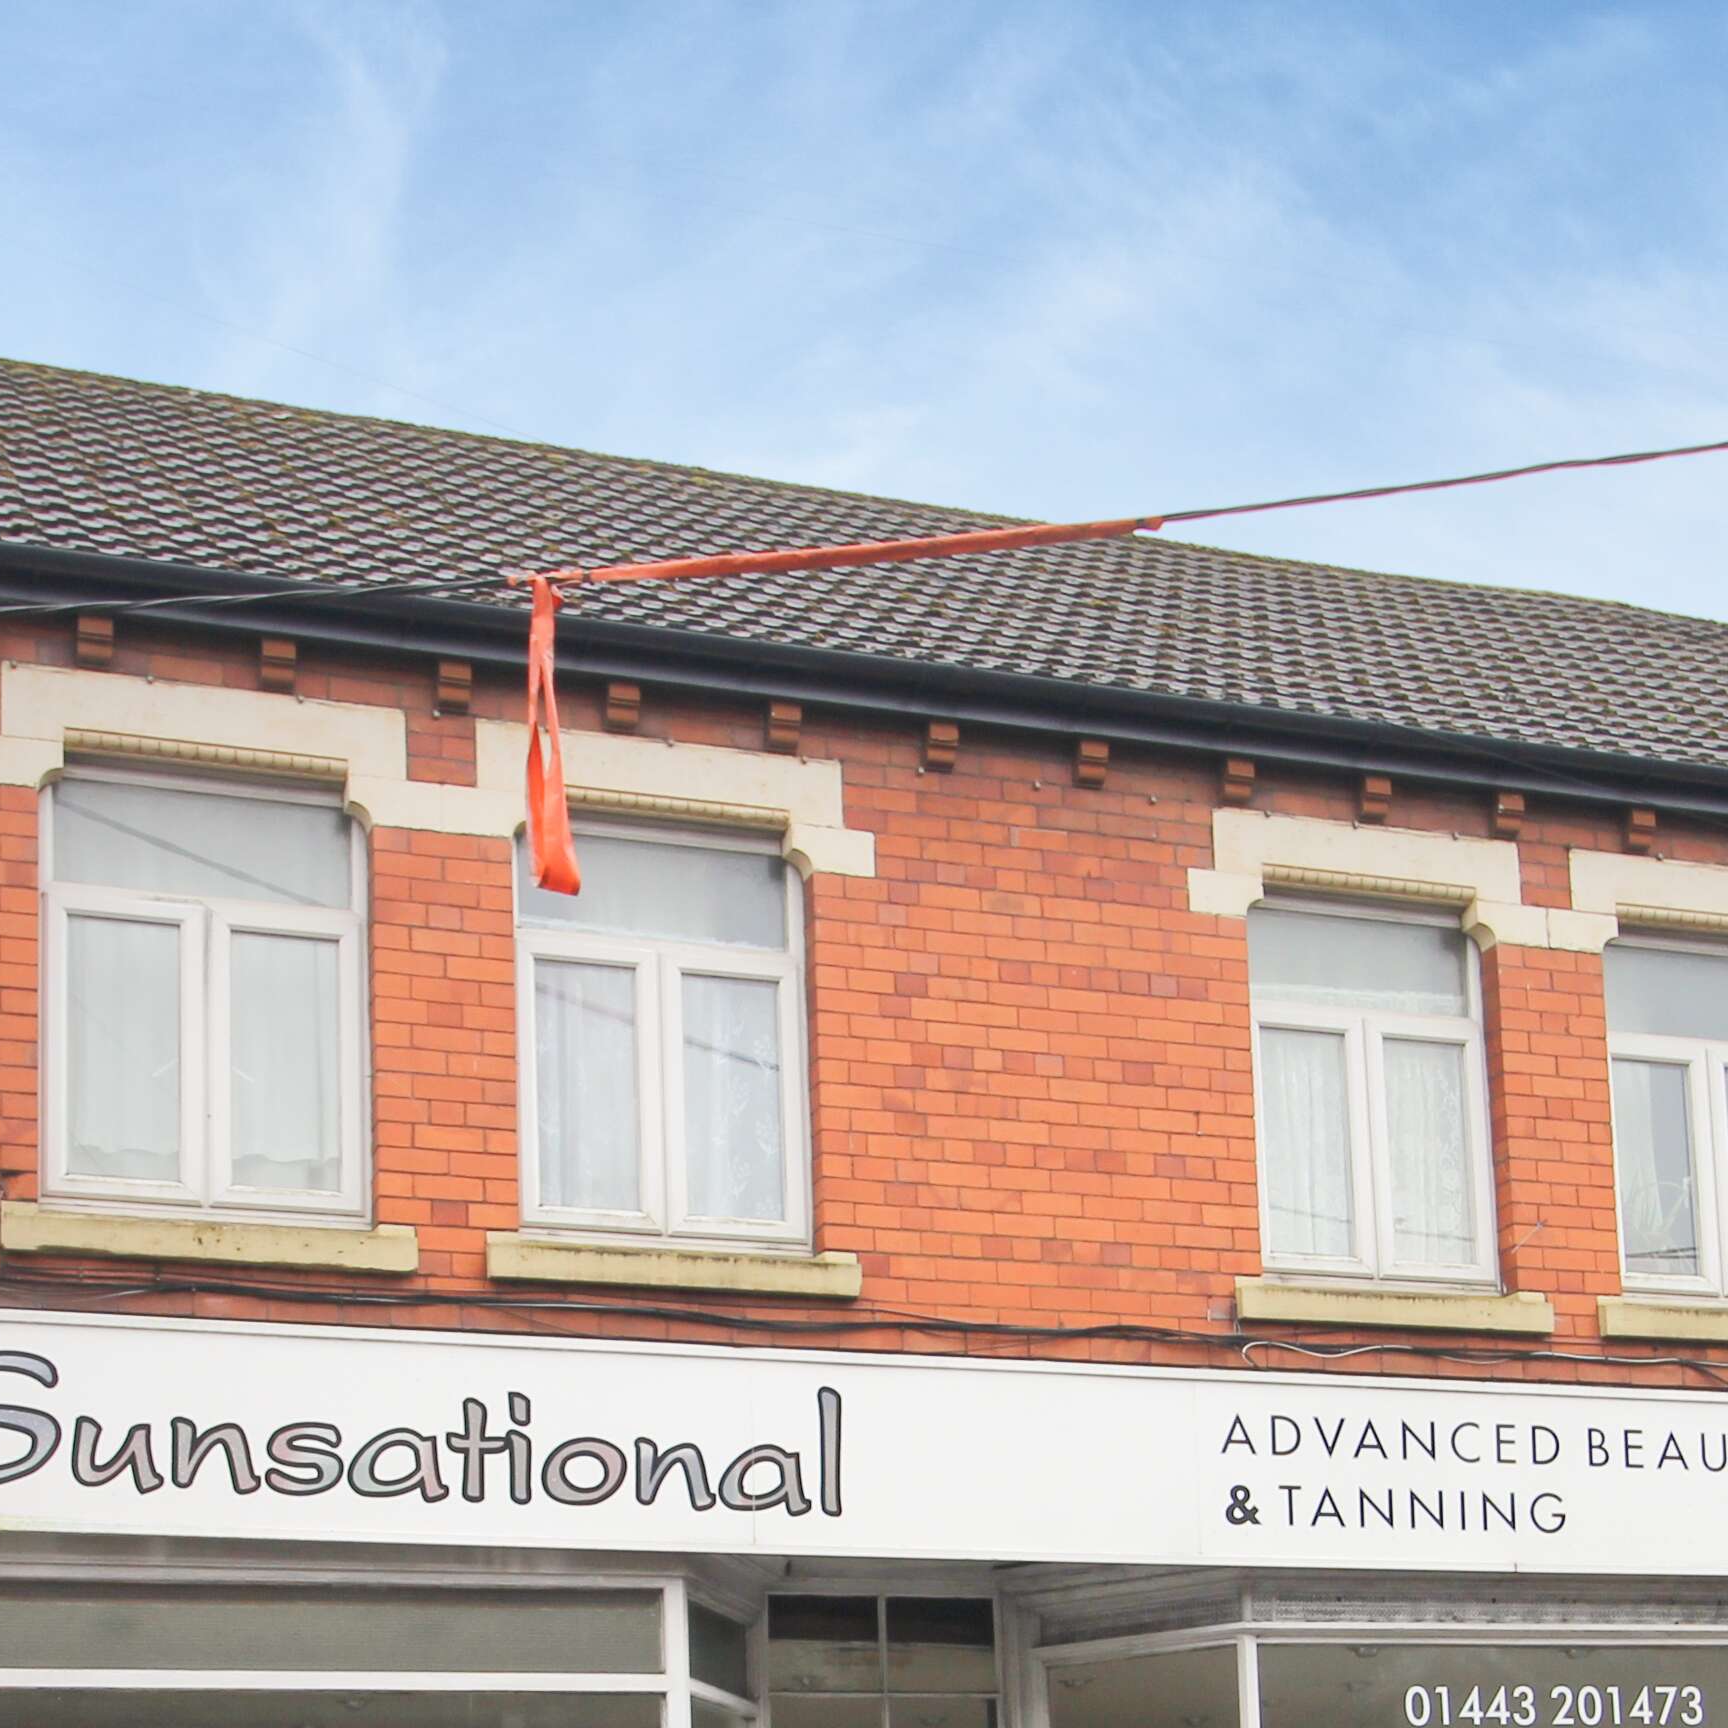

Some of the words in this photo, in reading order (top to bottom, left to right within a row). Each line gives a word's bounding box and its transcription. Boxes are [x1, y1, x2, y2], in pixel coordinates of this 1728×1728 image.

[1220, 1413, 1561, 1465] ADVANCED
[1225, 1485, 1262, 1525] &
[1279, 1485, 1567, 1534] TANNING
[1404, 1685, 1536, 1727] 01443
[1551, 1685, 1705, 1726] 201473
